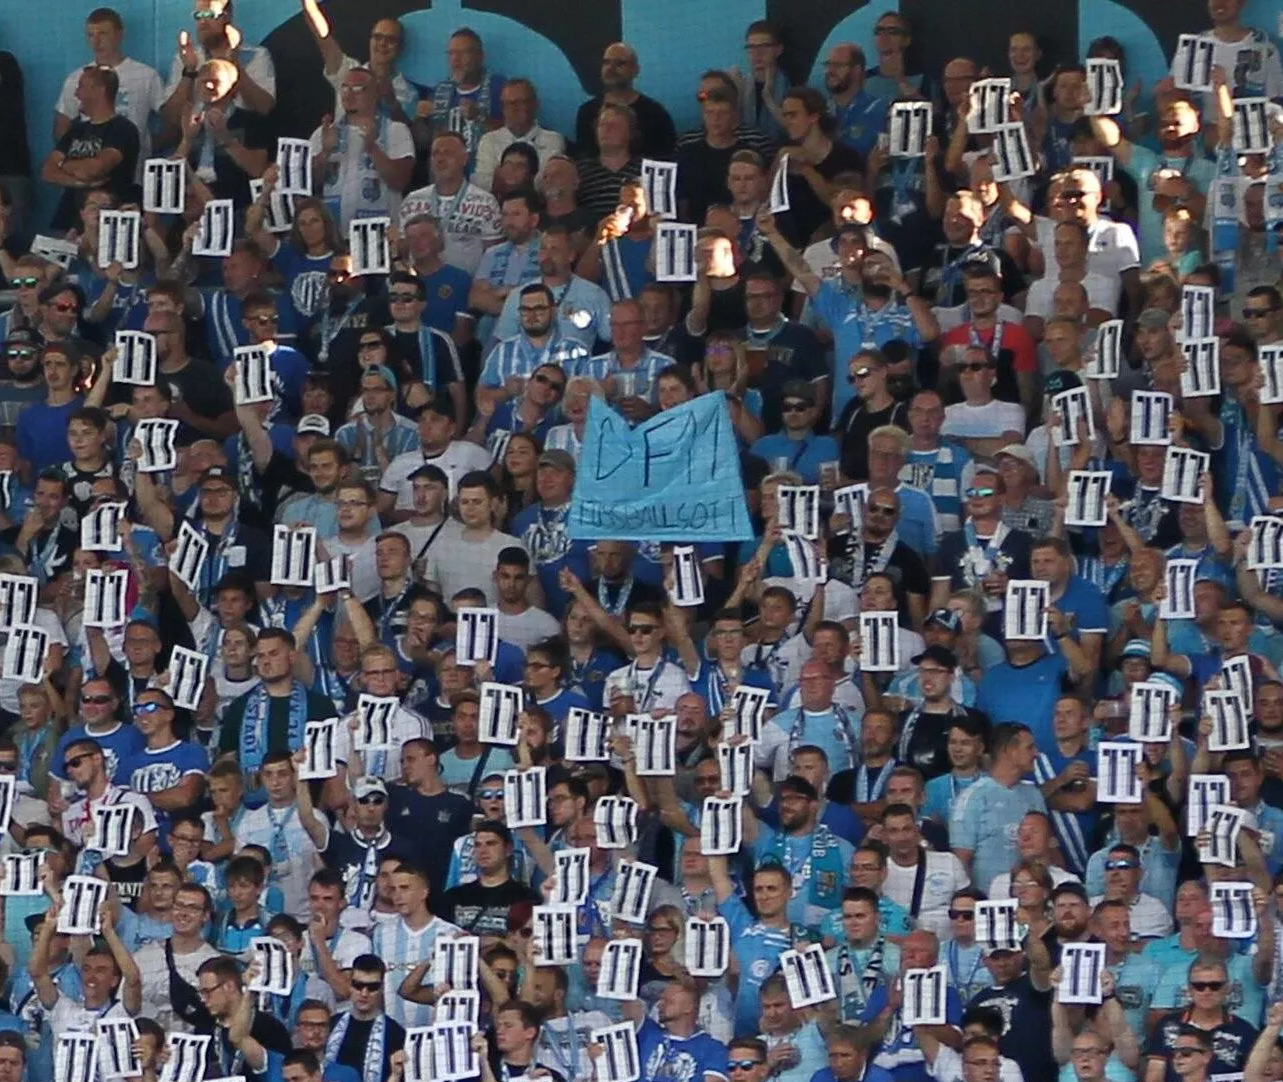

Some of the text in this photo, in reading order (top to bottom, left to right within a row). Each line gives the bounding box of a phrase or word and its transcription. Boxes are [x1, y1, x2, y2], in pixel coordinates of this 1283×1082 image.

[148, 164, 181, 209] 11
[661, 230, 694, 275] 11
[1073, 475, 1108, 521] 11
[91, 574, 122, 622] 11
[14, 628, 47, 679] 11
[864, 617, 895, 666] 11
[641, 721, 672, 770] 11
[508, 772, 541, 821] 11
[559, 854, 586, 903] 11
[690, 922, 724, 969] 11
[908, 971, 942, 1018] 11
